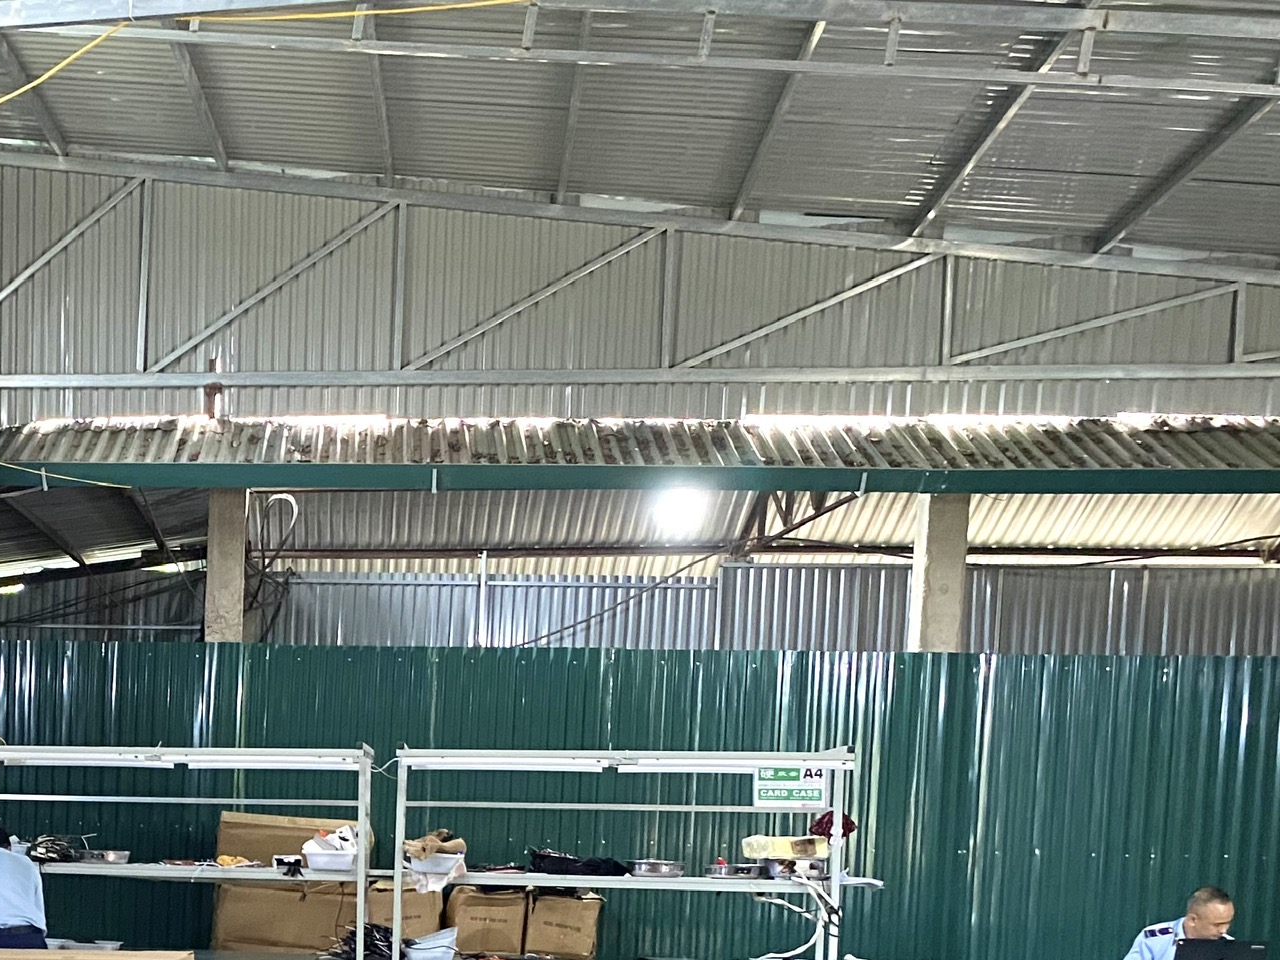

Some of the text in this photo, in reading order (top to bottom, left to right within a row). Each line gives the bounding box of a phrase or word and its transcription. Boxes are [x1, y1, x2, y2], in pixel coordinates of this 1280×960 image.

[803, 768, 823, 779] A4
[760, 789, 820, 797] CARD CASE
